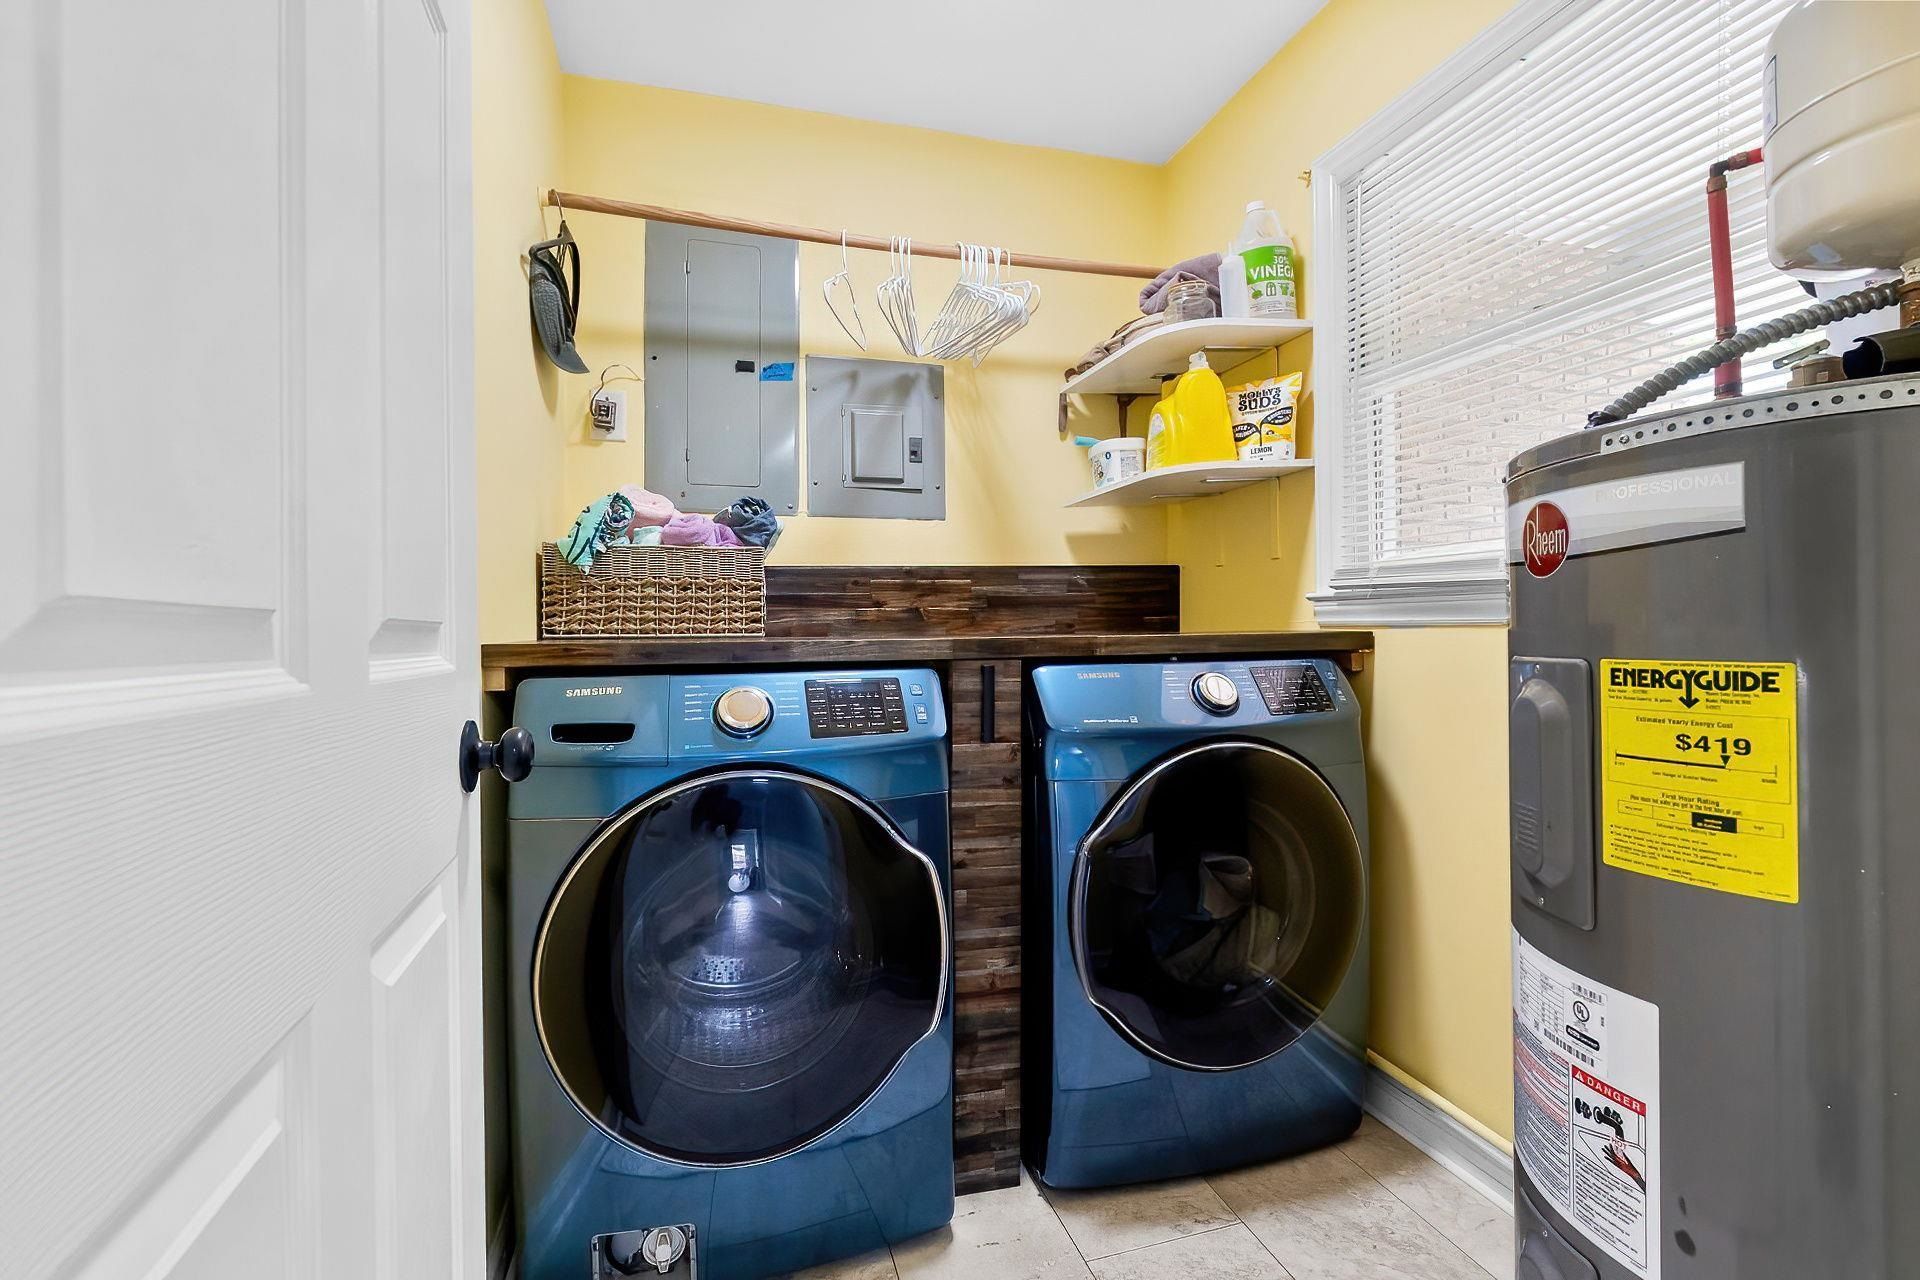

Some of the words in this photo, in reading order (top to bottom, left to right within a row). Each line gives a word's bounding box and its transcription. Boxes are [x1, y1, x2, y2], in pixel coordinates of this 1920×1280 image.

[1238, 387, 1281, 401] MOLLY'S
[1238, 393, 1281, 411] SUDS
[1250, 446, 1272, 455] LEMON
[1526, 504, 1566, 565] Rheem
[1076, 672, 1120, 680] SAMSUNG
[1610, 668, 1781, 693] ENERGYGUIDE
[566, 686, 622, 698] SAMSUNG
[1636, 716, 1666, 724] Estimated
[1668, 718, 1690, 727] Yearly
[1690, 720, 1716, 729] Energy
[1675, 734, 1752, 756] $419
[1662, 792, 1676, 800] First
[1678, 794, 1694, 803] Hour
[1696, 797, 1720, 808] Rating
[1586, 1077, 1641, 1112] DANGER
[1611, 1136, 1628, 1148] HOT
